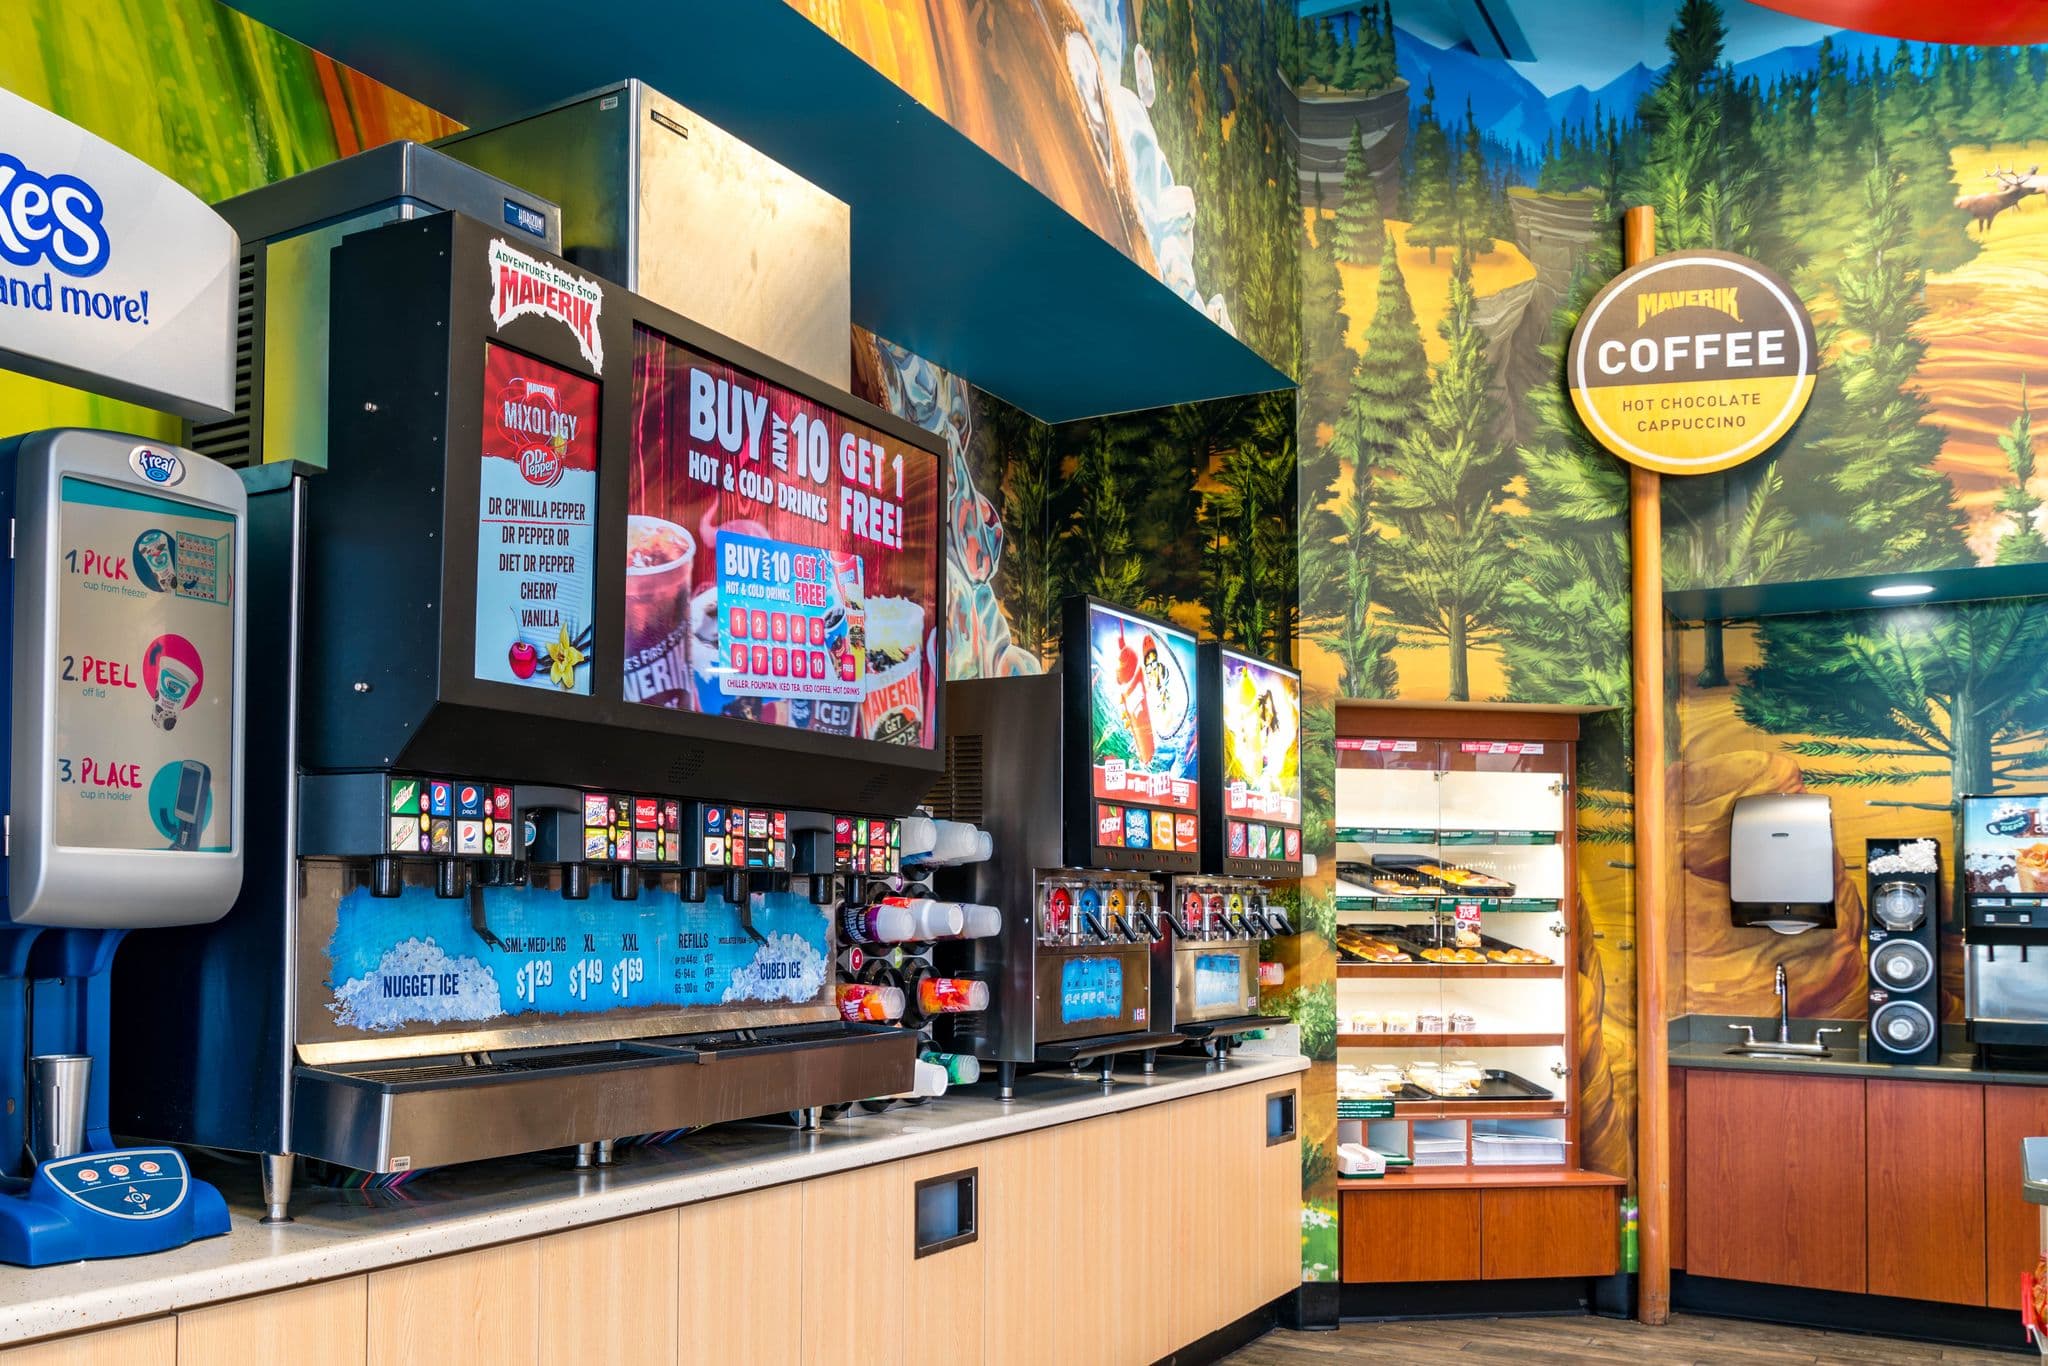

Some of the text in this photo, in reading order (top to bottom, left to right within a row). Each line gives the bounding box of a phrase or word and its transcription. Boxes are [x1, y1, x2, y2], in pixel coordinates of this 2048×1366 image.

[496, 249, 598, 301] ADVENTURE'S FIRST STOP
[61, 286, 149, 325] more!
[498, 265, 594, 354] MAVERIK
[1637, 287, 1742, 329] MAVERIK
[1598, 329, 1786, 375] COFFEE
[1622, 392, 1762, 412] HOT CHOCOLATE
[504, 400, 578, 441] MIXOLOGY
[690, 367, 905, 498] BUY ANY 10 GET 1
[1637, 415, 1746, 432] CAPPUCCINO
[523, 450, 556, 479] Pepper
[535, 448, 548, 464] Dr
[688, 450, 829, 525] HOT & COLD DRINKS
[489, 497, 586, 521] DR CH'NILLA PEPPER
[840, 486, 904, 549] FREE!
[502, 526, 569, 546] DR PEPPER OR
[65, 549, 129, 581] 1. PICK
[499, 553, 575, 573] DIET DR PEPPER
[725, 543, 760, 579] BUY
[762, 548, 771, 582] ANY
[771, 551, 790, 583] 10
[794, 553, 817, 581] GET
[83, 581, 148, 598] cup from freezer
[520, 582, 558, 601] CHERRY
[725, 580, 739, 595] HOT
[748, 584, 765, 598] COLD
[766, 587, 791, 602] DRINKS
[795, 581, 828, 608] FREE!
[521, 609, 560, 627] VANILLA
[755, 617, 762, 633] 2
[776, 619, 782, 635] 3
[794, 622, 801, 637] 4
[813, 623, 820, 639] 5
[62, 655, 137, 688] 2. PEEL
[735, 651, 823, 672] 6 7 8 9 10
[82, 688, 105, 698] off lid
[779, 682, 791, 692] ICED
[802, 684, 813, 693] ICED
[832, 685, 844, 695] HOT
[844, 686, 860, 695] DRINKS
[815, 702, 851, 726] ICED
[58, 757, 143, 788] 3. PLACE
[80, 791, 133, 800] cup in holder
[583, 933, 596, 953] XL
[622, 933, 639, 952] XXL
[678, 933, 709, 948] REFILLS
[516, 960, 553, 1003] $129
[569, 958, 604, 1000] $149
[611, 957, 644, 998] $169
[760, 961, 801, 980] CUBED ICE
[382, 973, 460, 998] NUGGET ICE
